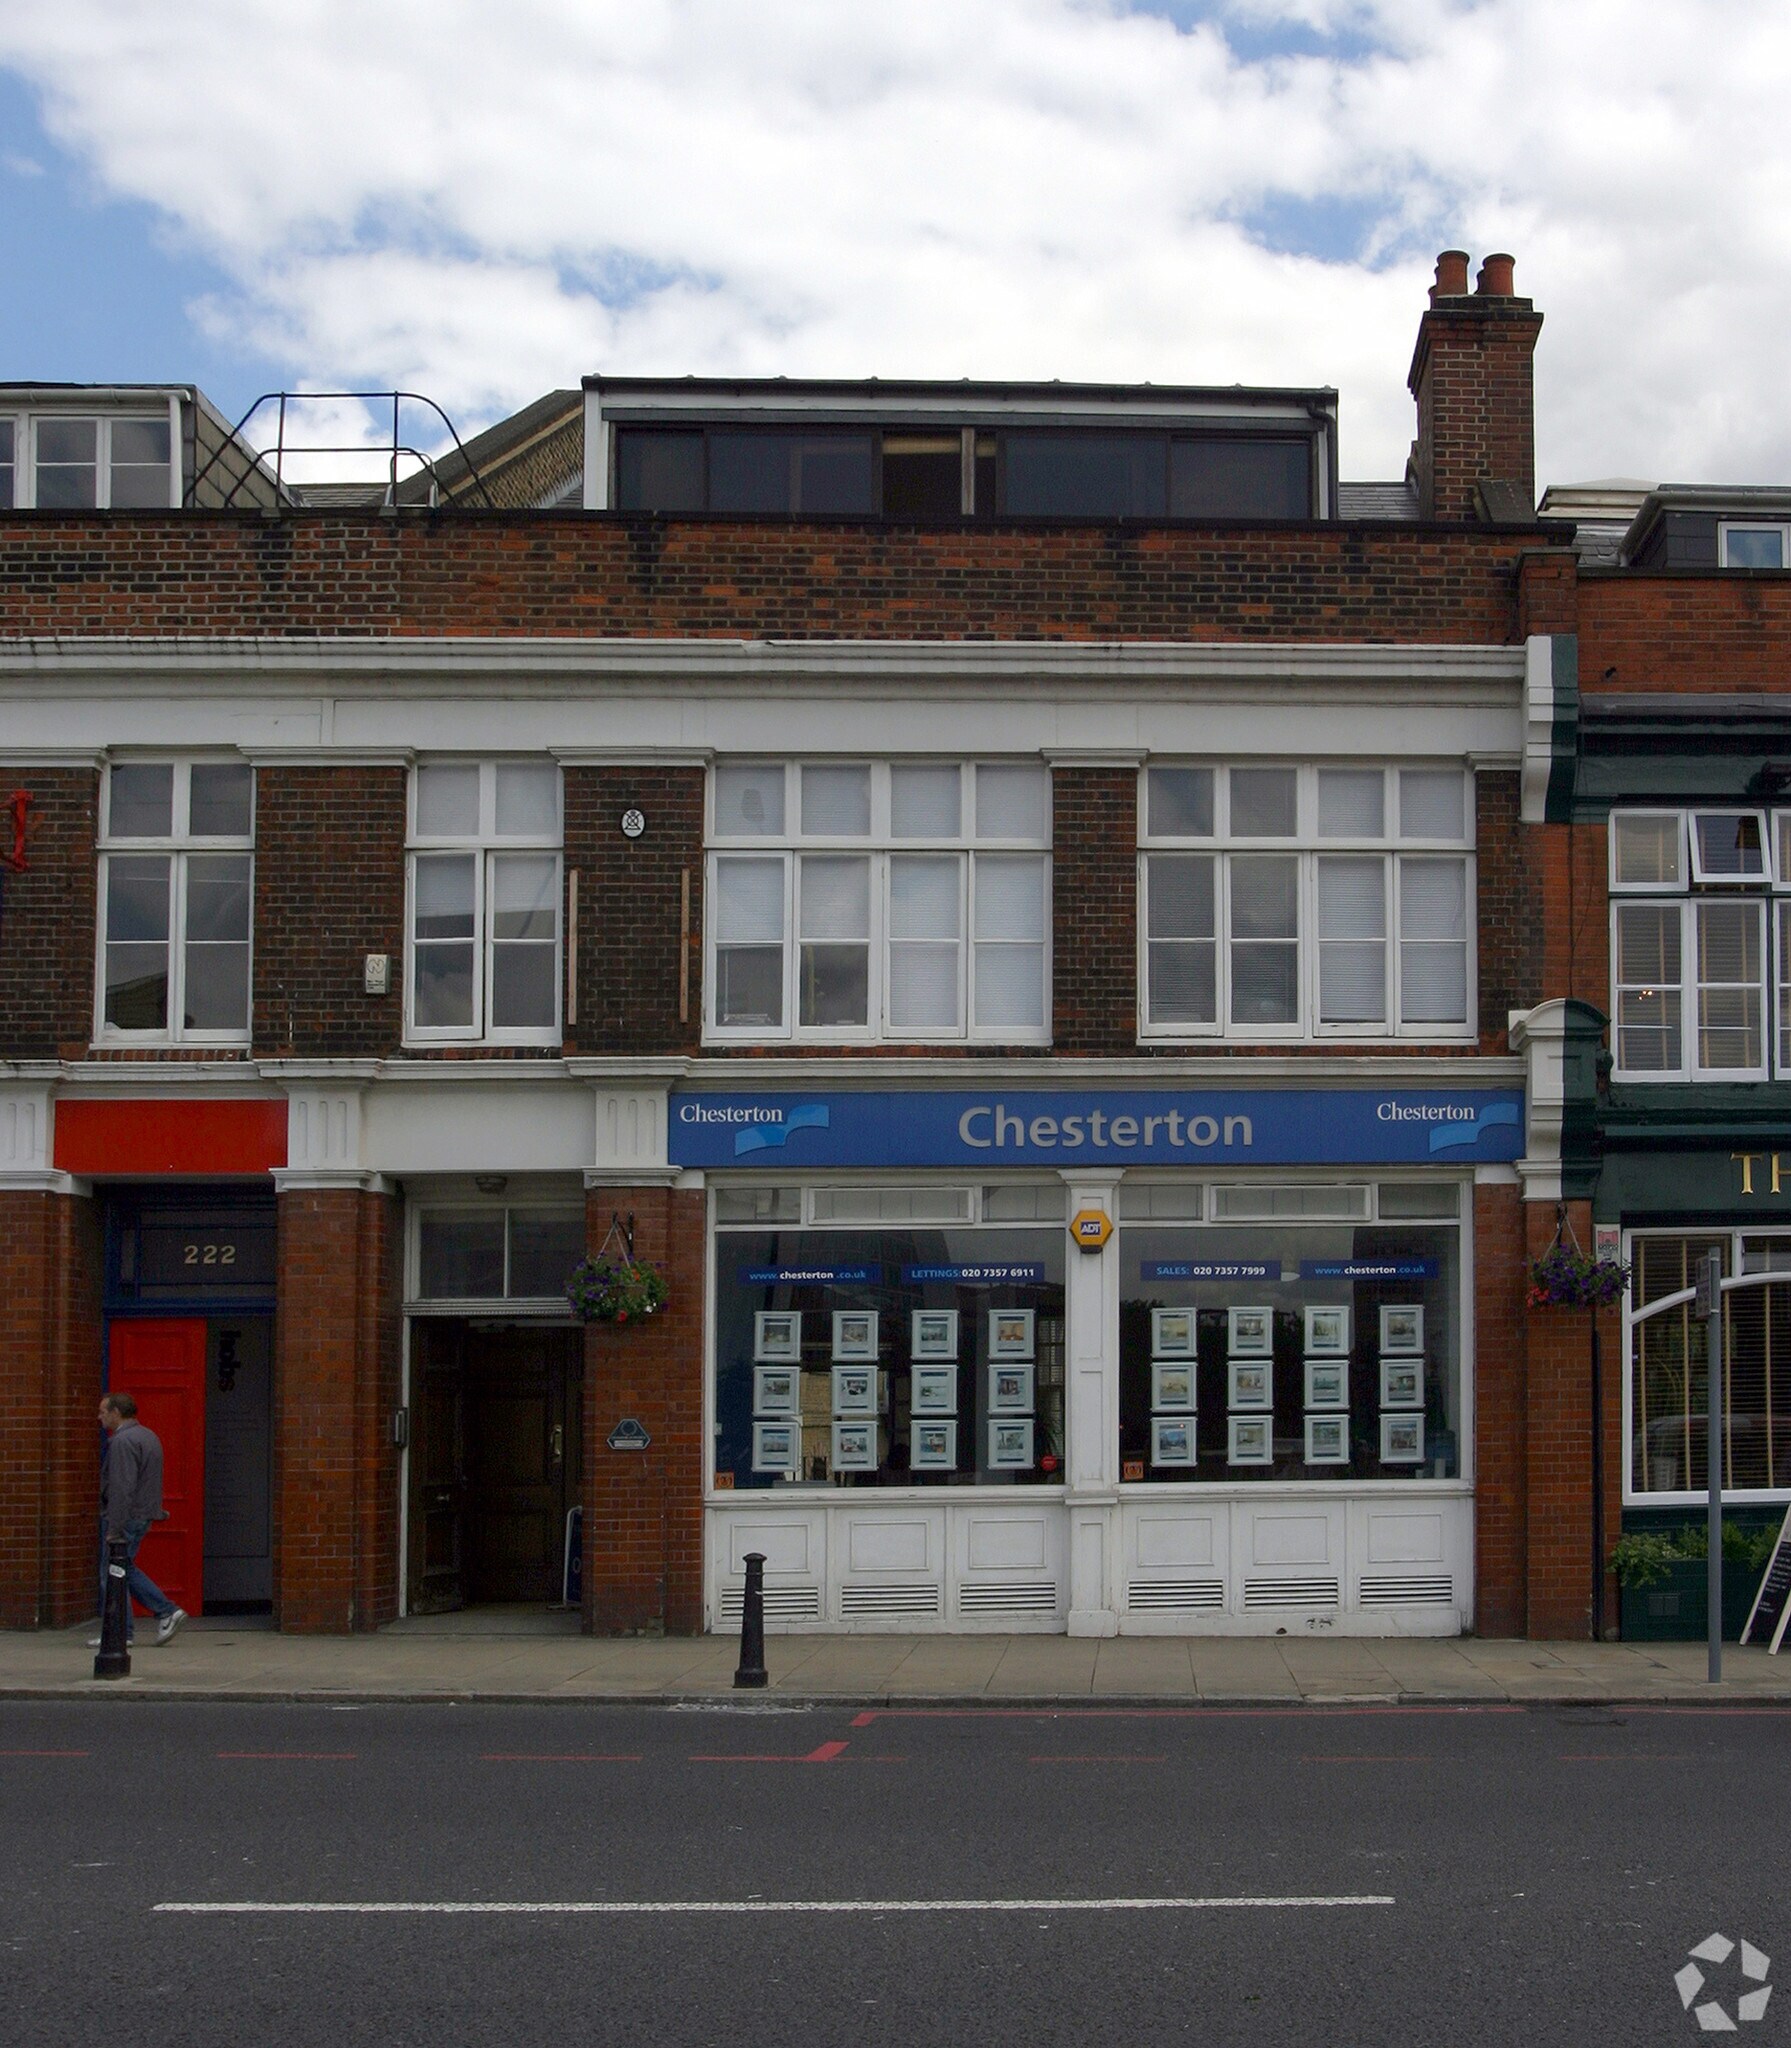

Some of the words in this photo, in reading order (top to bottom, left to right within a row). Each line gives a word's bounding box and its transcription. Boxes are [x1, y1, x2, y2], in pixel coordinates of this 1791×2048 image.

[680, 1103, 783, 1123] Chesterton
[1376, 1101, 1475, 1121] Chesterton
[958, 1104, 1253, 1147] Chesterton
[1081, 1223, 1100, 1234] ADT
[184, 1245, 236, 1264] 222
[983, 1267, 1008, 1277] 7357
[1010, 1267, 1035, 1277] 6911
[1156, 1266, 1190, 1275] SALES:
[1193, 1266, 1212, 1275] 020
[1214, 1266, 1239, 1275] 7357
